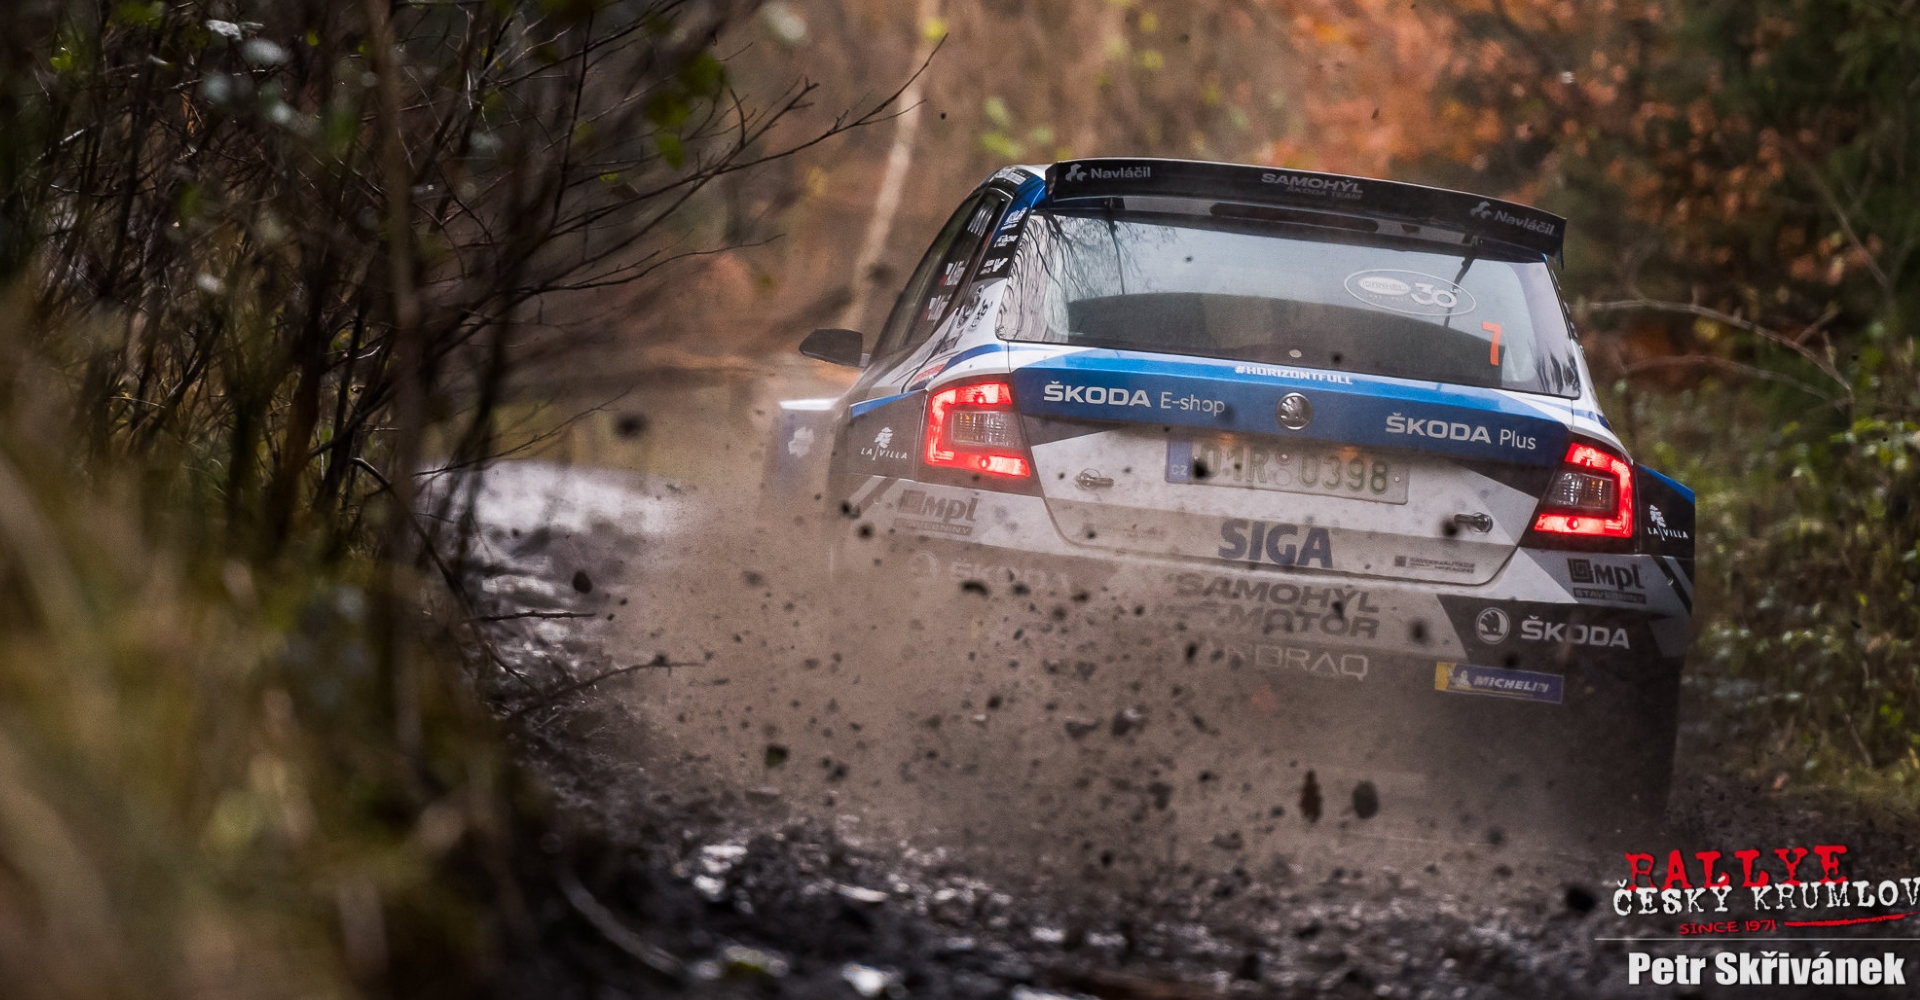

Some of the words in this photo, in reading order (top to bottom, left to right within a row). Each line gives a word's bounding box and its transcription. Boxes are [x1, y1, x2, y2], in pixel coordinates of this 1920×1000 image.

[1090, 165, 1151, 181] Navláčil
[1261, 173, 1364, 194] SAMOHÝL
[1494, 209, 1556, 236] Navláčil
[1482, 321, 1502, 366] 7
[1235, 365, 1353, 386] #HORIZONTFULL
[1043, 381, 1151, 408] ŠKODA
[1160, 391, 1225, 416] E-shop
[1385, 412, 1491, 444] ŠKODA
[1499, 428, 1537, 450] Plus
[879, 449, 908, 460] VILLA
[1171, 464, 1188, 477] CZ
[1218, 518, 1334, 569] SIGA
[1662, 528, 1689, 540] VILLA
[1229, 603, 1381, 639] MOTOR
[1520, 615, 1631, 650] ŠKODA
[1474, 675, 1550, 694] MICHELIN
